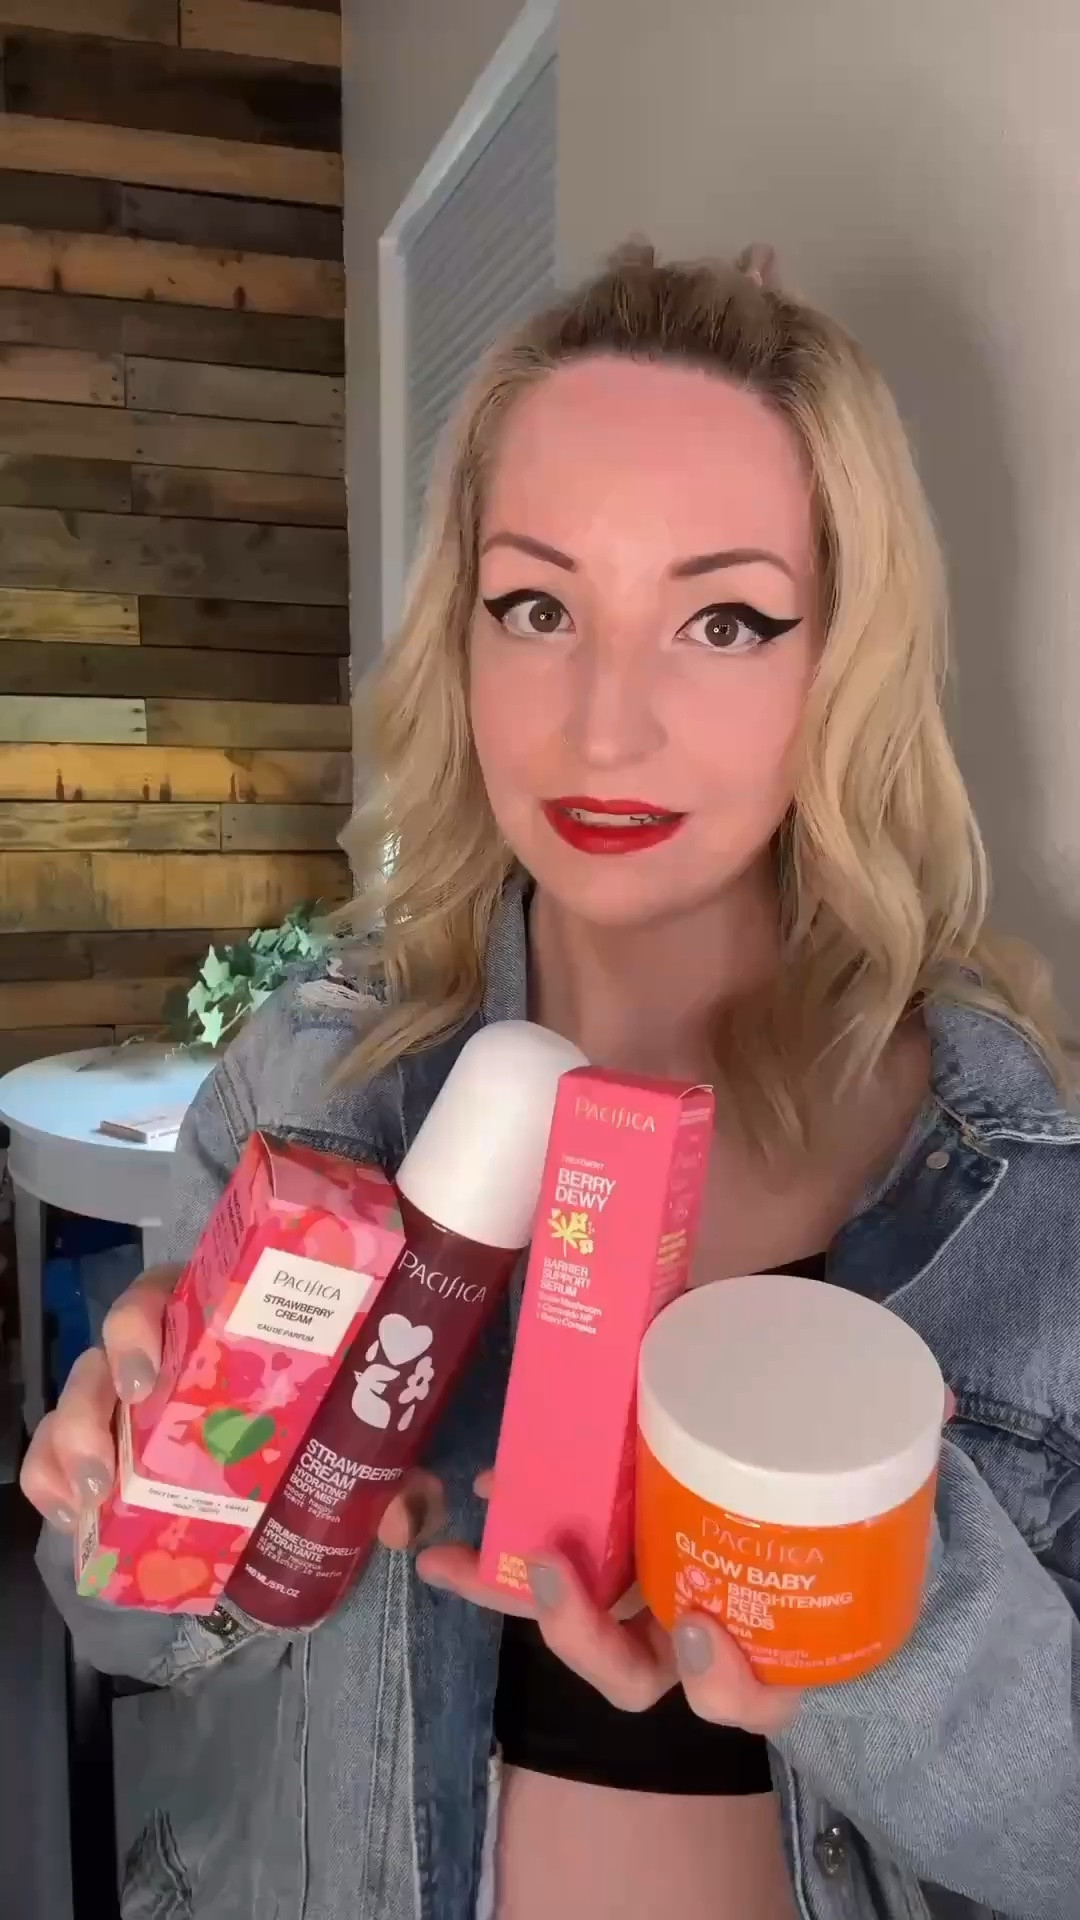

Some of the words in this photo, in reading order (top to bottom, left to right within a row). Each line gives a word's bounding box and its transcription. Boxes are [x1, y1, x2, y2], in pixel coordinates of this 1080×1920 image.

[558, 1167, 616, 1196] BERRY
[555, 1185, 609, 1212] DEWY
[273, 1270, 342, 1301] PACIFICA
[397, 1250, 487, 1303] PACIFICA
[540, 1279, 578, 1297] SERUM
[541, 1267, 591, 1289] SUPPORT
[263, 1293, 335, 1319] STRAWBERRY
[275, 1308, 313, 1326] CREAM
[257, 1323, 273, 1333] EAU
[272, 1326, 284, 1336] DE
[283, 1329, 315, 1342] PARFUM
[294, 1464, 348, 1501] HYDRATING
[300, 1452, 357, 1492] CREAM
[289, 1473, 318, 1498] BODY
[314, 1492, 339, 1507] MIST
[263, 1526, 325, 1562] HYDRATANTE
[268, 1517, 301, 1545] BRUME
[675, 1531, 743, 1579] GLOW
[747, 1566, 817, 1591] BABY
[727, 1595, 769, 1617] PEEL
[728, 1581, 853, 1609] BRIGHTENING
[727, 1608, 775, 1631] PADS
